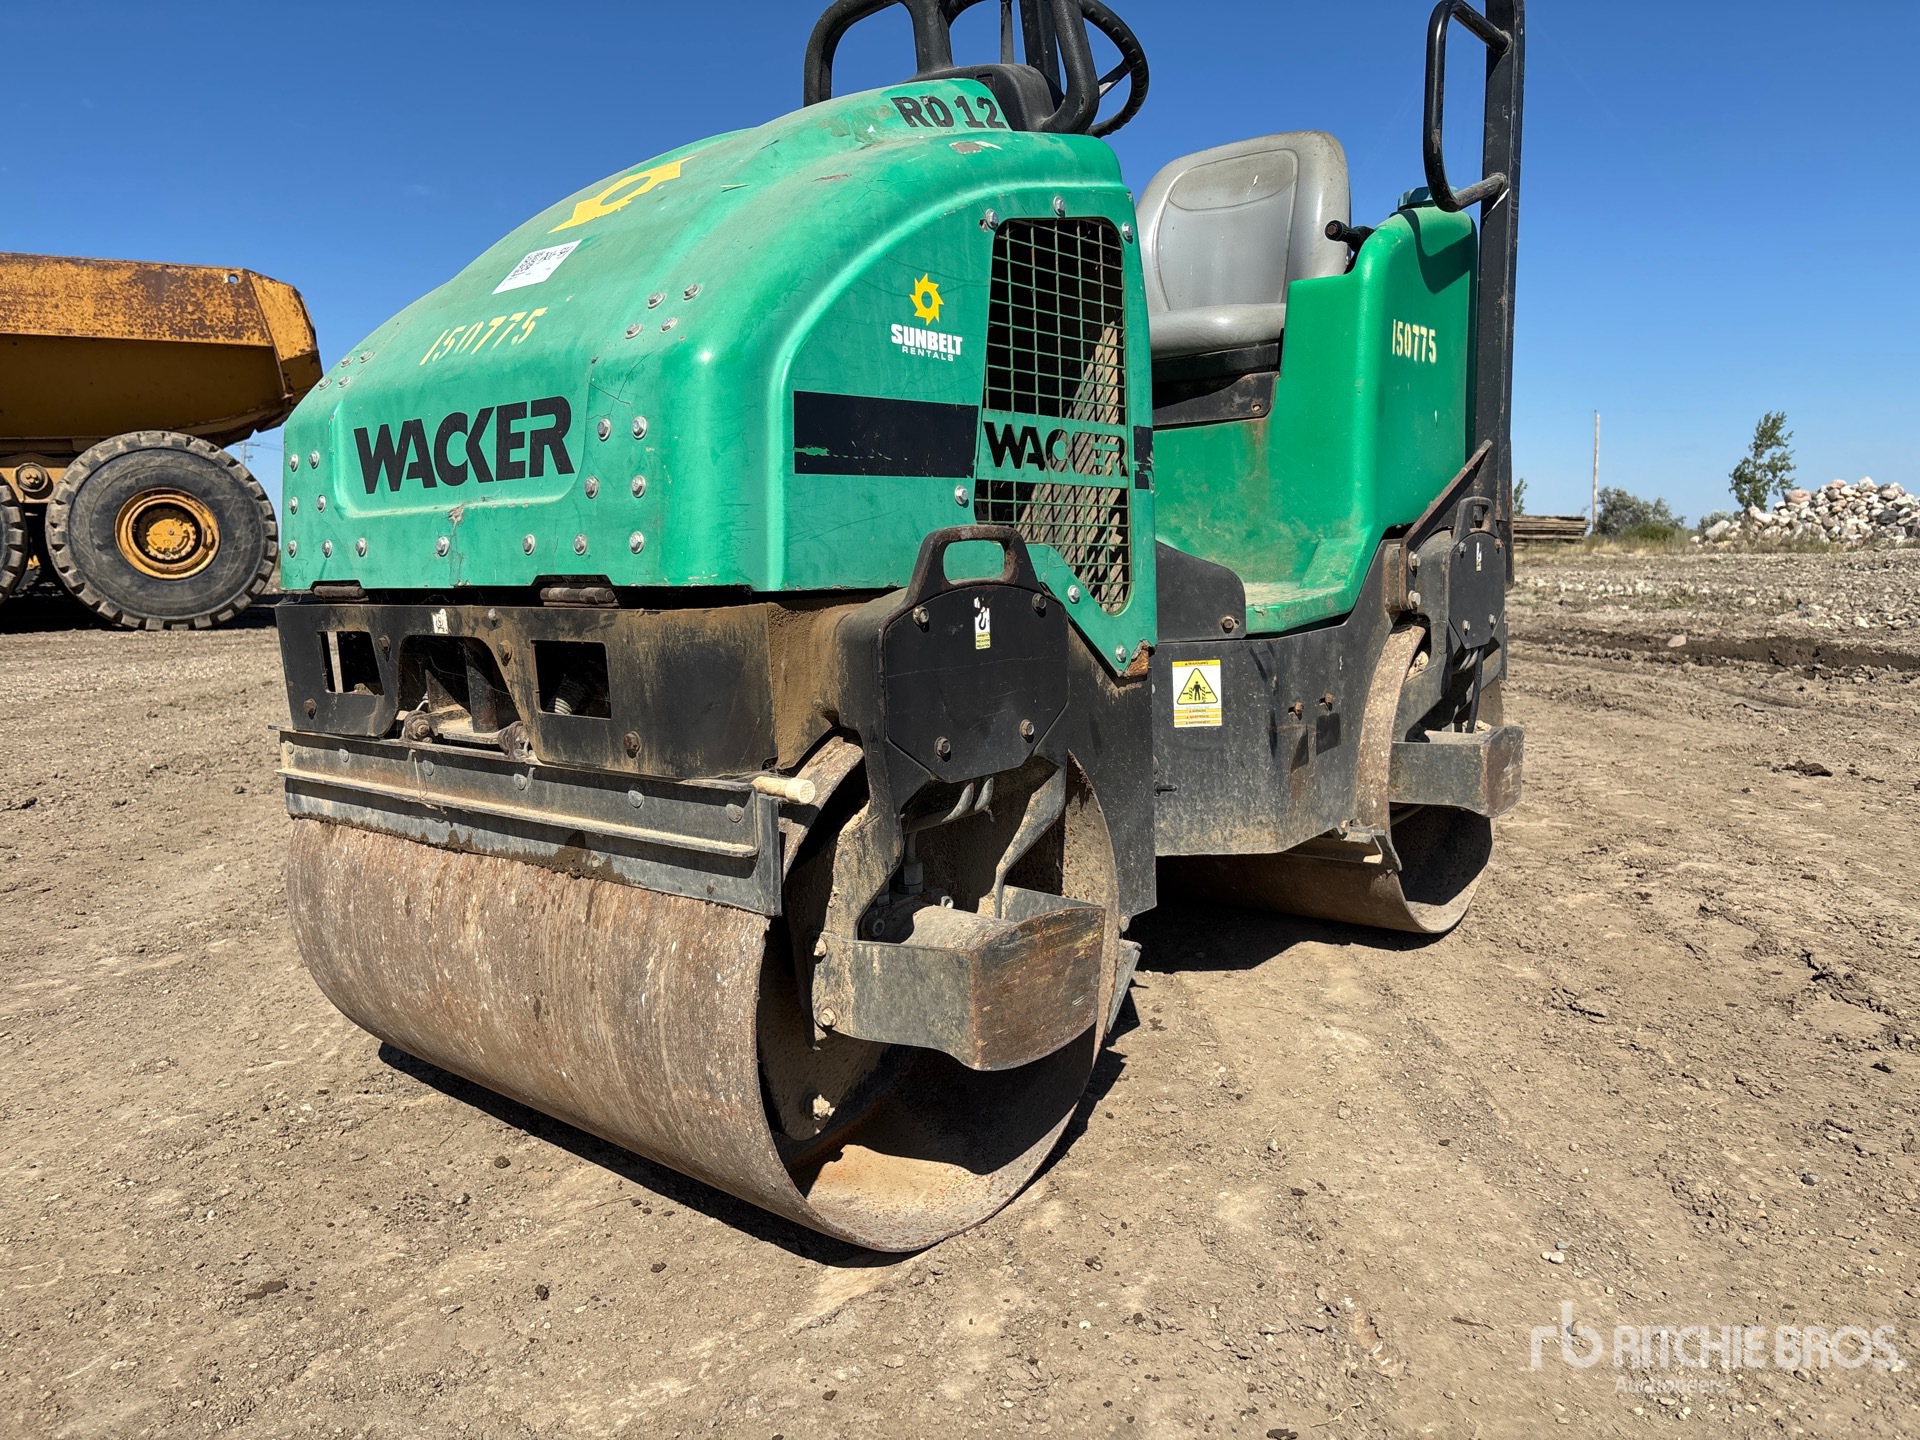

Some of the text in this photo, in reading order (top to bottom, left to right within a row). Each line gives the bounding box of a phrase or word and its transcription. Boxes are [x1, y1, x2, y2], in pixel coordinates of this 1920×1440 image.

[890, 95, 1007, 128] RD 12
[419, 306, 548, 366] 150775
[890, 323, 963, 356] SUNBELT
[901, 345, 955, 362] RENTALS
[1391, 318, 1437, 365] 150775
[353, 394, 575, 495] WACKER
[982, 420, 1129, 477] WACKER
